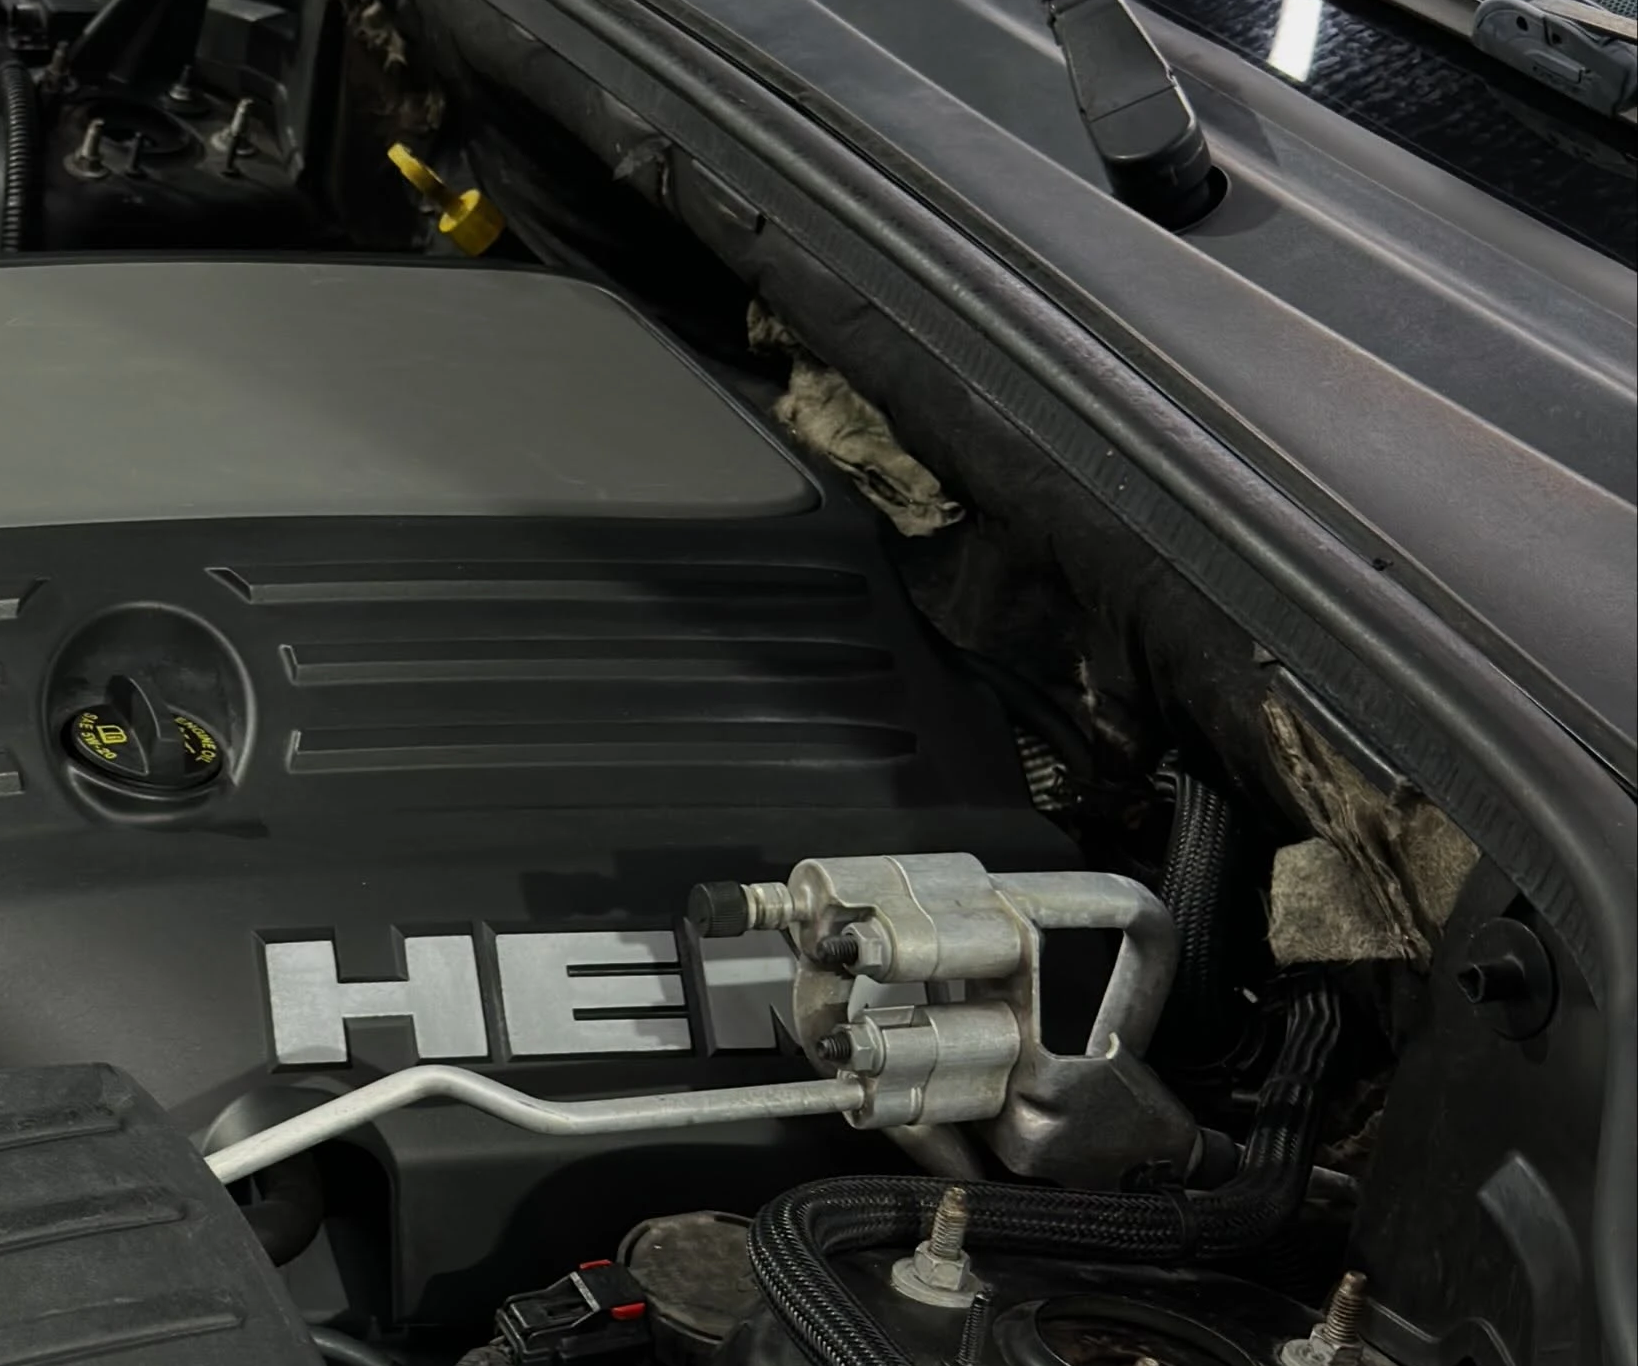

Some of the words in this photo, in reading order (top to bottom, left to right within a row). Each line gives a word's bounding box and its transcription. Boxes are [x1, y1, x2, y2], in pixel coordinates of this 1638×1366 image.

[79, 712, 99, 730] SAE
[174, 717, 217, 750] ENGINE
[81, 731, 117, 759] 5W-20
